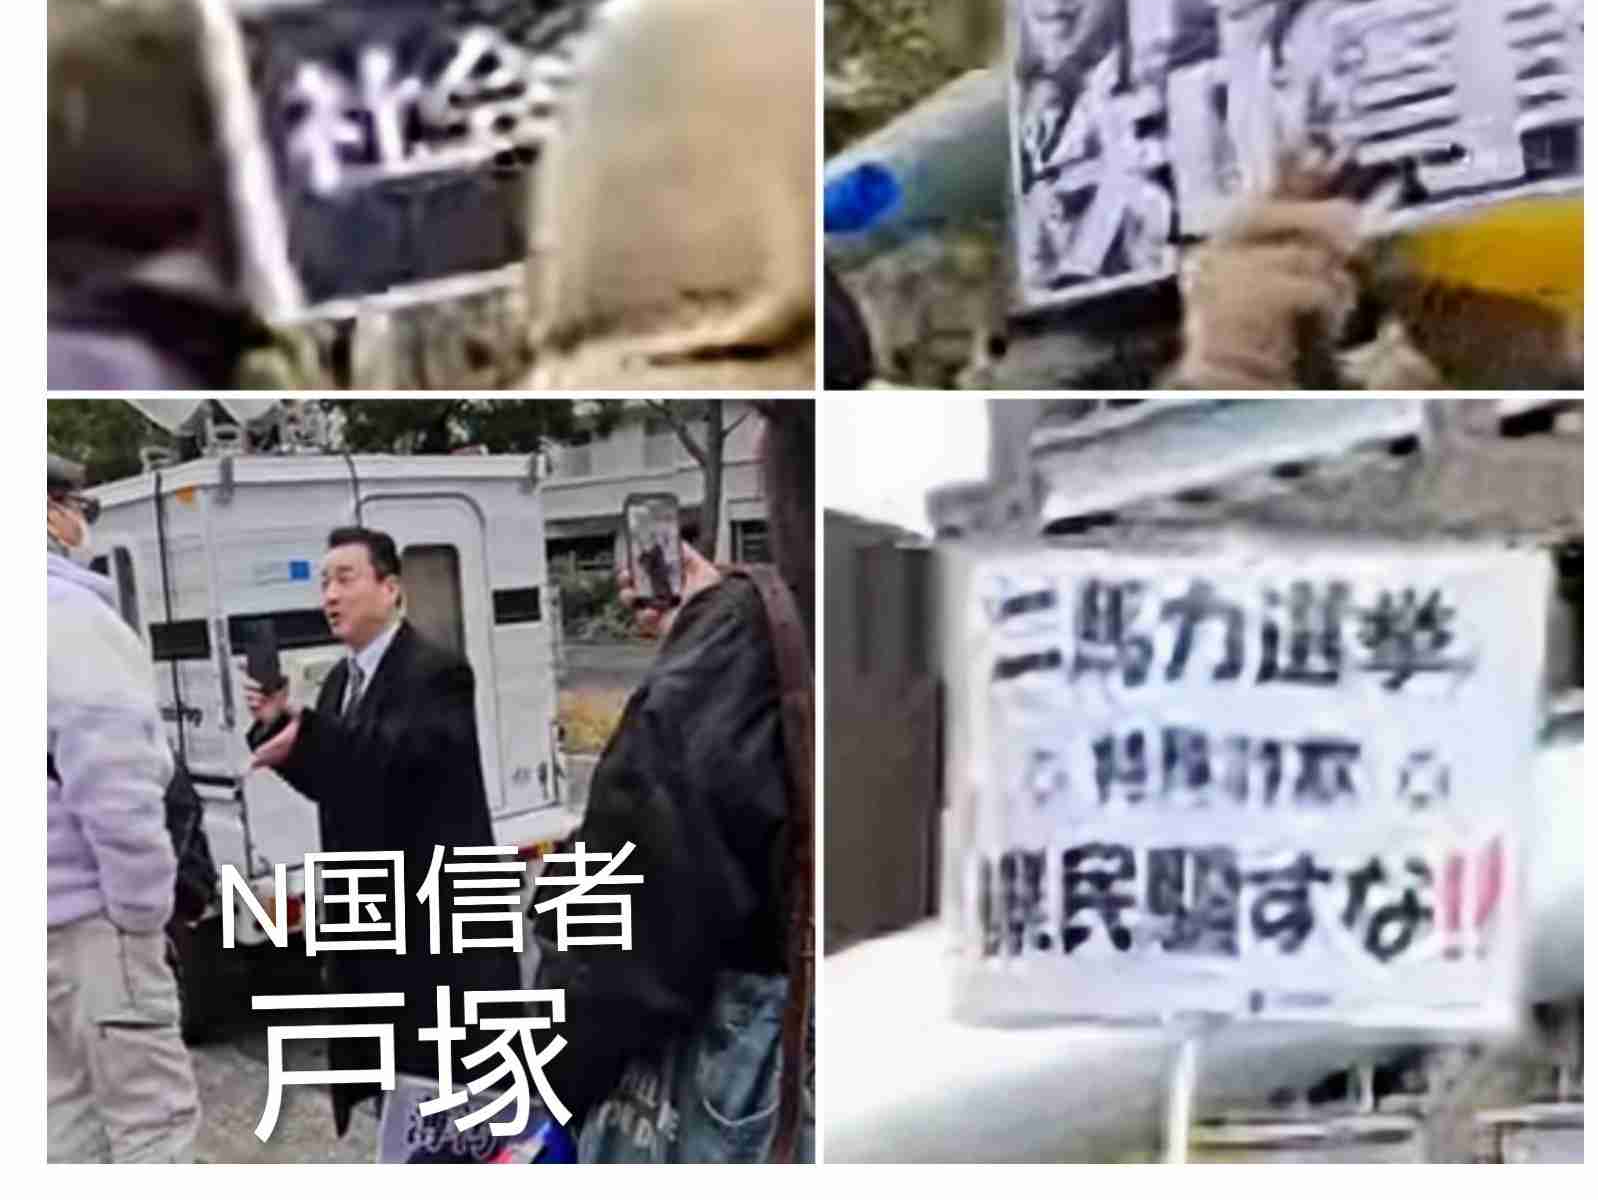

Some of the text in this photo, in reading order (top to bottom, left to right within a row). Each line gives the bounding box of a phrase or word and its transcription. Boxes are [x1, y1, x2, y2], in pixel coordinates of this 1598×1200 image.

[988, 576, 1476, 692] 二馬力選挙
